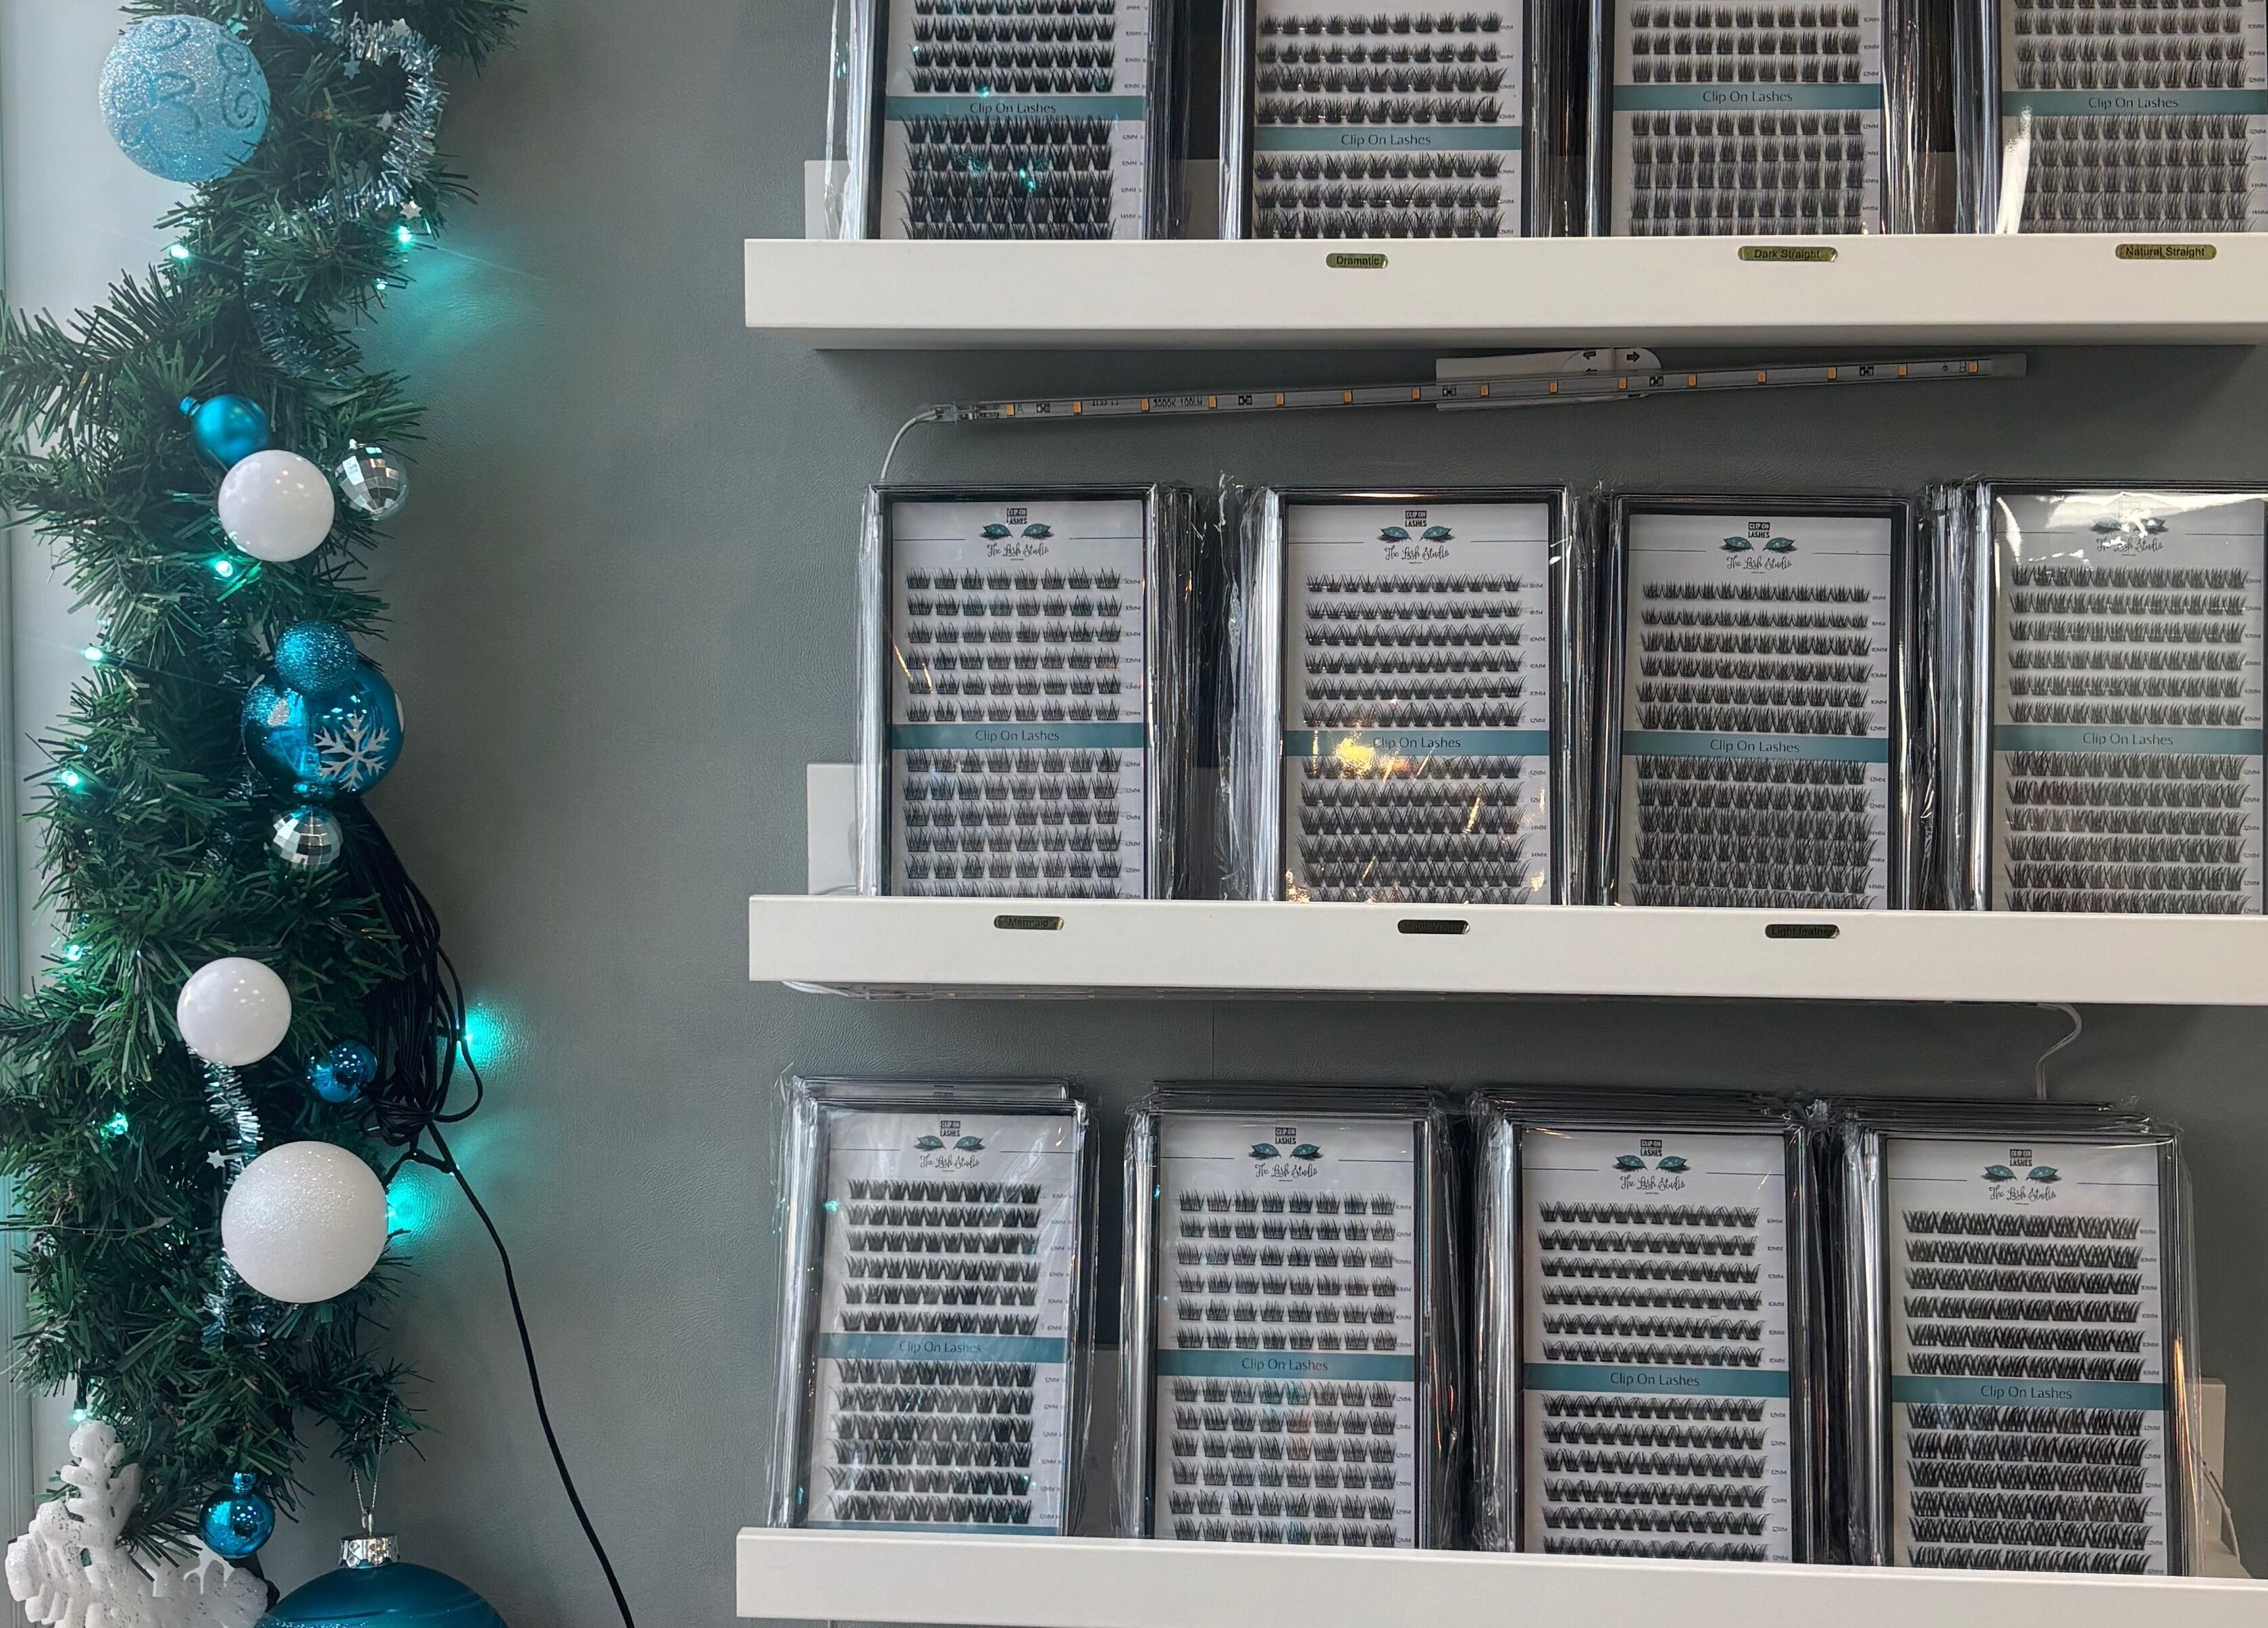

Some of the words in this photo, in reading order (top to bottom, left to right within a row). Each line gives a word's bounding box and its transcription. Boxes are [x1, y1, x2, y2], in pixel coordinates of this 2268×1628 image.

[1703, 91, 1726, 104] Clip
[1730, 91, 1747, 102] On
[1752, 91, 1793, 102] Lashes
[2088, 97, 2111, 109] Clip
[2115, 97, 2133, 108] On
[2138, 96, 2179, 108] Lashes
[970, 102, 992, 114] Clip
[996, 103, 1013, 113] On
[1017, 102, 1056, 113] Lashes
[1341, 134, 1364, 147] Clip
[1368, 134, 1386, 145] On
[1391, 133, 1431, 145] Lashes
[1754, 249, 1778, 258] Dark
[1781, 249, 1820, 259] Straight
[2125, 247, 2162, 257] Natural
[2166, 246, 2205, 258] Straight
[1337, 255, 1379, 265] Dramatic
[975, 730, 997, 742] Clip
[1000, 730, 1018, 740] On
[1022, 730, 1060, 741] Lashes
[1399, 737, 1417, 748] On
[1421, 736, 1461, 748] Lashes
[2083, 732, 2106, 745] Clip
[2110, 733, 2128, 744] On
[2133, 733, 2173, 744] Lashes
[1710, 739, 1733, 753] Clip
[1737, 740, 1755, 751] On
[1759, 742, 1800, 753] Lashes
[900, 1341, 921, 1354] Clip
[924, 1341, 941, 1352] On
[945, 1342, 981, 1353] Lashes
[1242, 1358, 1264, 1371] Clip
[1268, 1358, 1285, 1369] On
[1289, 1359, 1328, 1371] Lashes
[1610, 1372, 1634, 1386] Clip
[1637, 1373, 1655, 1384] On
[1659, 1374, 1699, 1386] Lashes
[1981, 1385, 2005, 1400] Clip
[2008, 1386, 2026, 1398] On
[2031, 1387, 2072, 1399] Lashes
